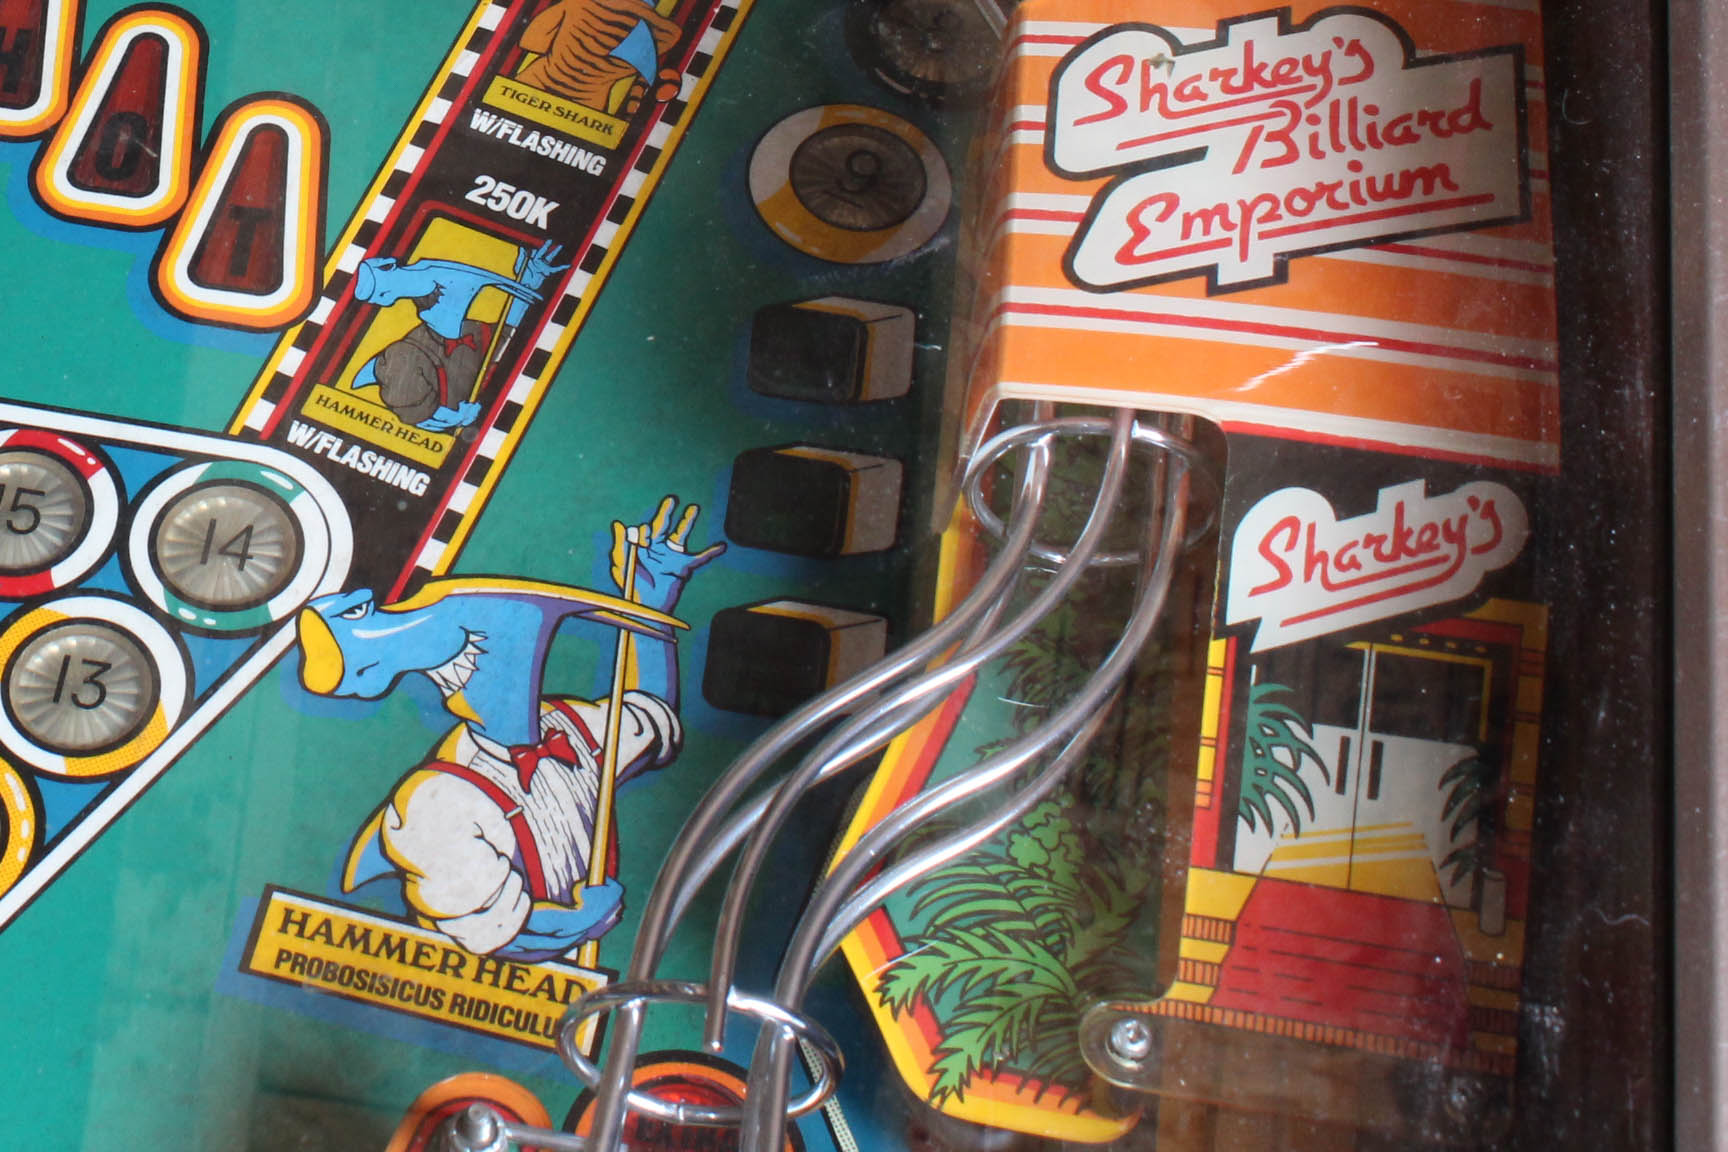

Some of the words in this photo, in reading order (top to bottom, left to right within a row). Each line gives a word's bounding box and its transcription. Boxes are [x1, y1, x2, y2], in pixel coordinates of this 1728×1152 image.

[500, 85, 553, 113] TIGER
[553, 106, 615, 136] SHARK
[1074, 37, 1375, 127] Sharkey's
[470, 108, 608, 177] W/FLASHING
[1172, 78, 1494, 175] Billiard
[465, 174, 561, 230] 250K
[1114, 160, 1464, 264] Emporium
[286, 420, 432, 497] W/FLASHING
[315, 394, 394, 435] HAMMER
[395, 426, 444, 455] HEAD
[200, 518, 255, 573] 14
[1248, 495, 1504, 608] Sharkey's
[51, 654, 113, 711] 13
[274, 947, 447, 1012] PROBOSISICUS
[447, 994, 561, 1040] RIDICULU
[277, 907, 465, 980] HAMMER
[471, 952, 589, 1008] HEAD
